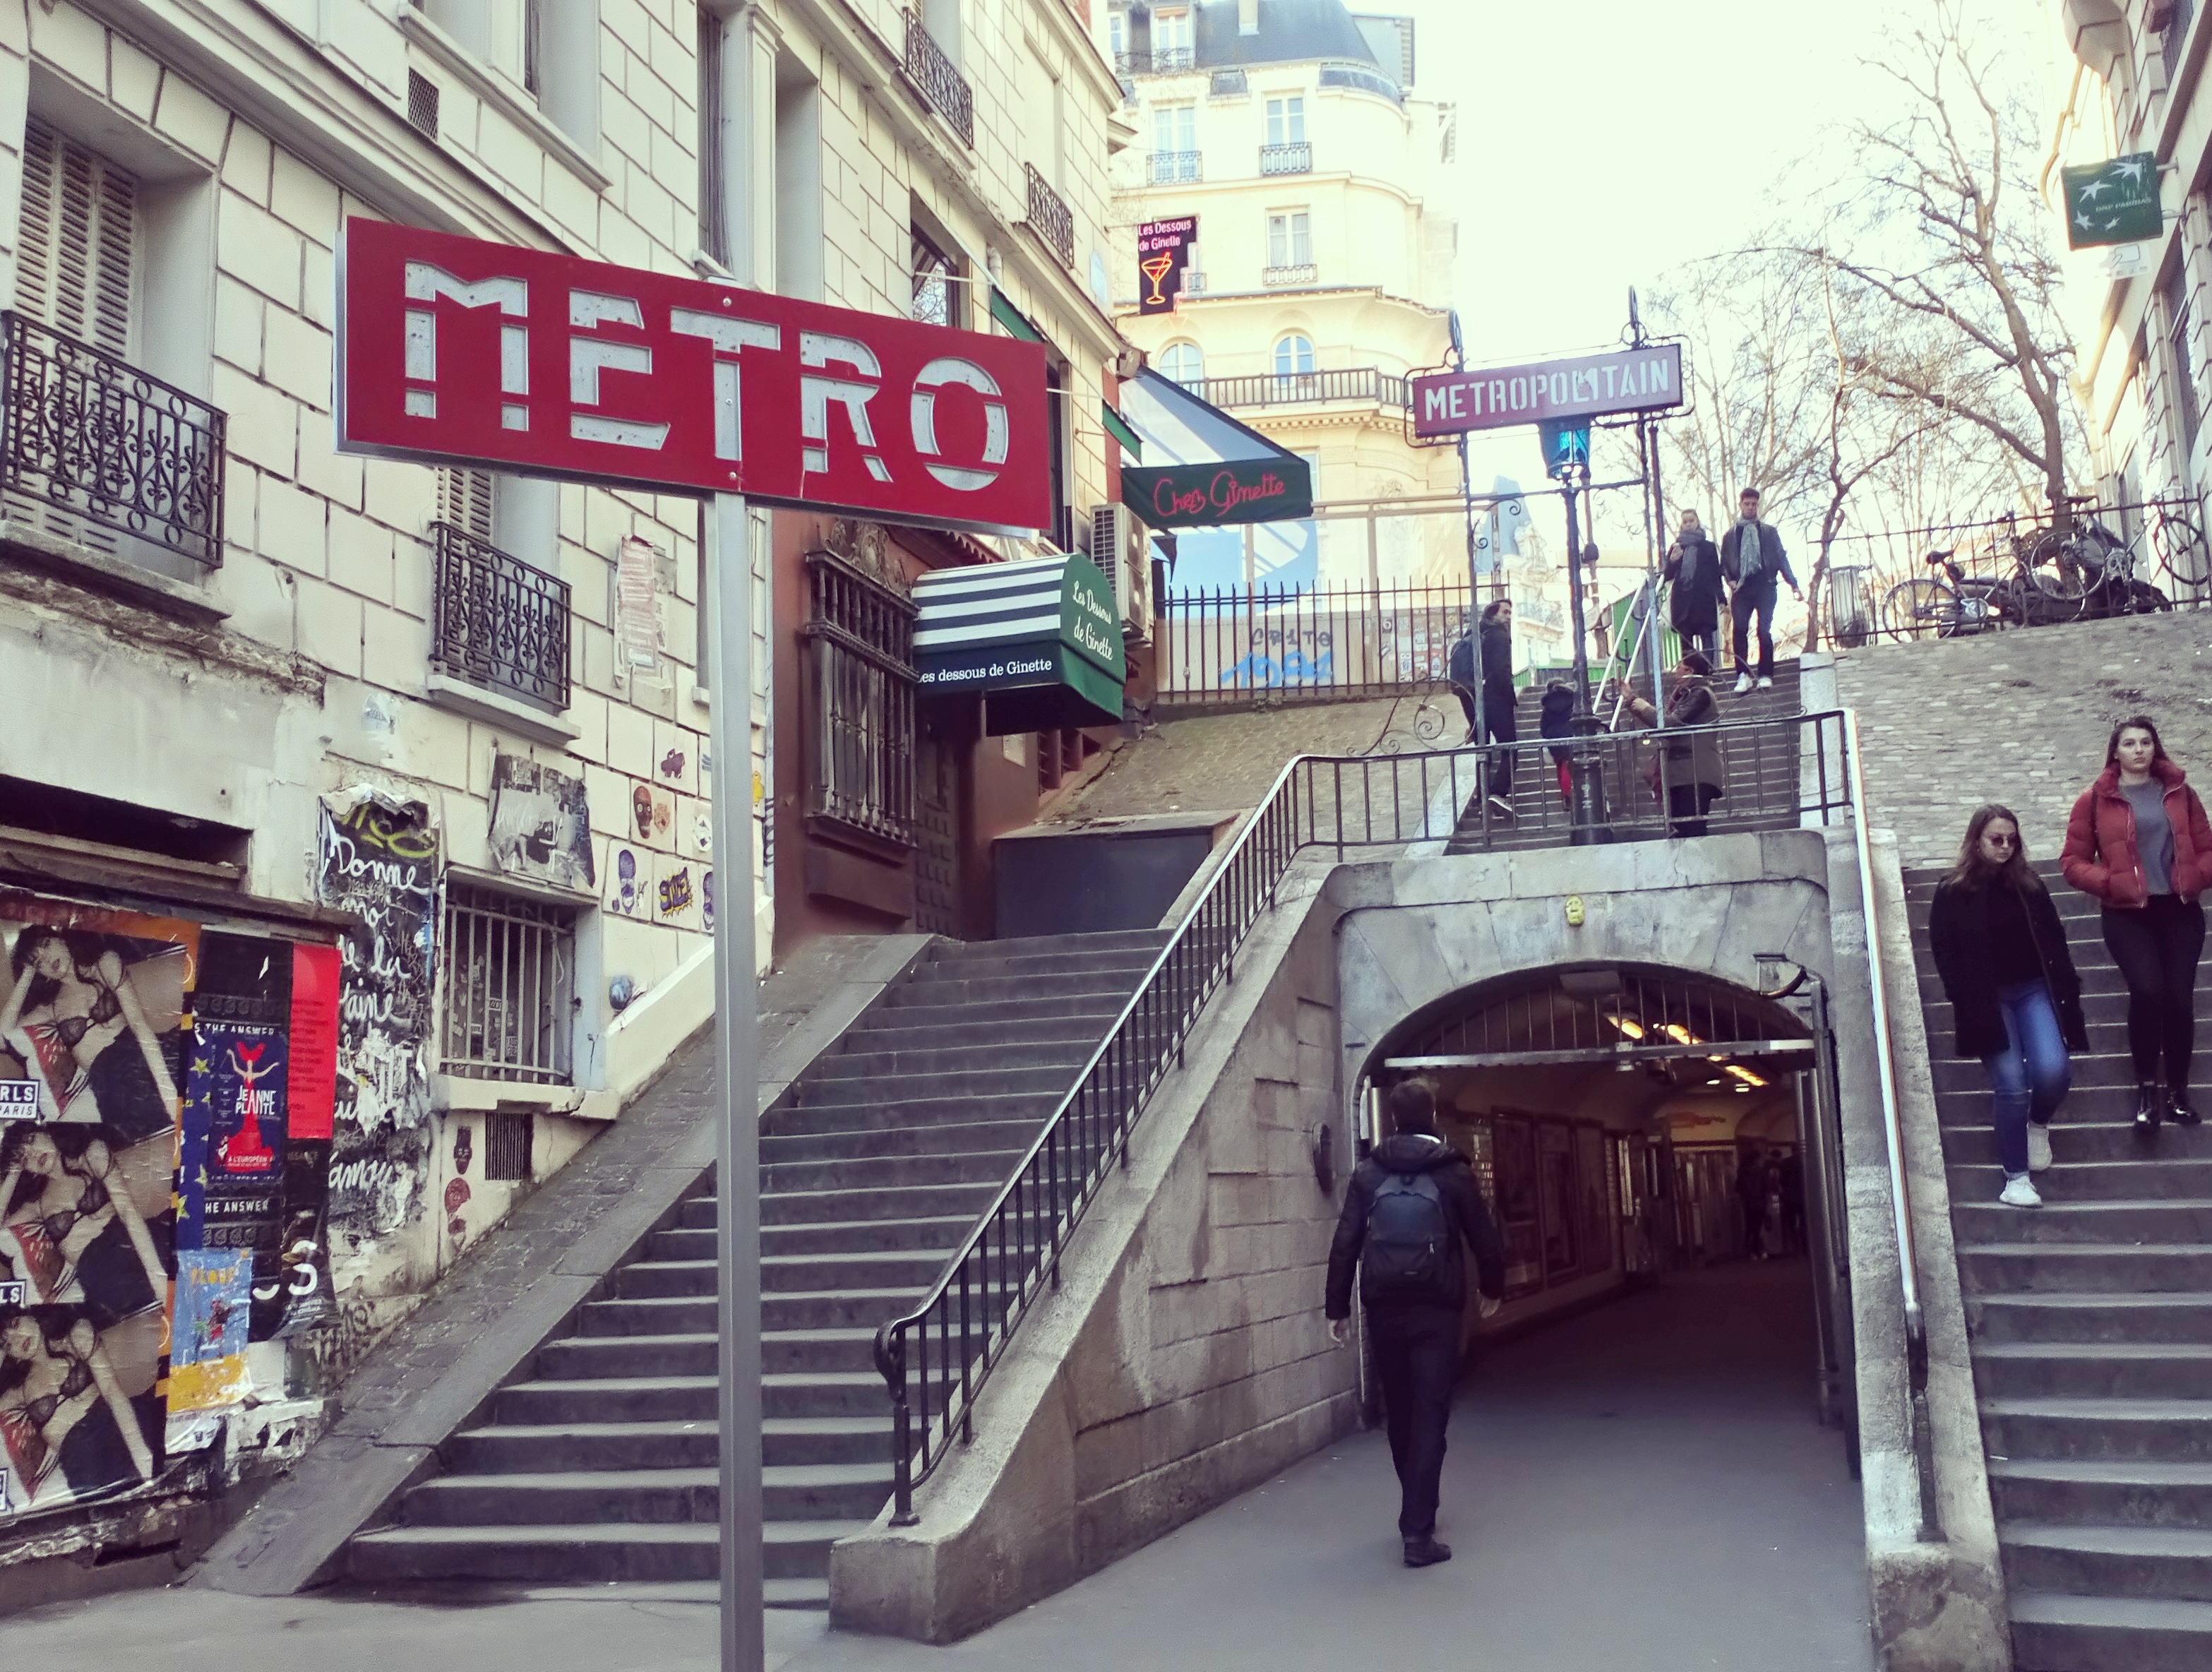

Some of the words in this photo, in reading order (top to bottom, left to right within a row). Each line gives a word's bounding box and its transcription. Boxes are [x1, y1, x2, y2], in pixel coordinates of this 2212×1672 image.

[1138, 225, 1154, 236] Les
[1154, 220, 1192, 234] Dessous
[1139, 240, 1149, 251] de
[405, 258, 1008, 491] METRO
[1210, 470, 1286, 517] Ginette
[1072, 580, 1085, 607] Les
[1087, 589, 1112, 625] Dessous
[1074, 615, 1084, 643] de
[1086, 622, 1113, 661] Ginette
[918, 672, 935, 683] es
[938, 669, 986, 682] dessous
[989, 664, 1004, 677] de
[1007, 659, 1053, 675] Ginette
[338, 837, 430, 896] Donne
[223, 1200, 269, 1212] ANSWER
